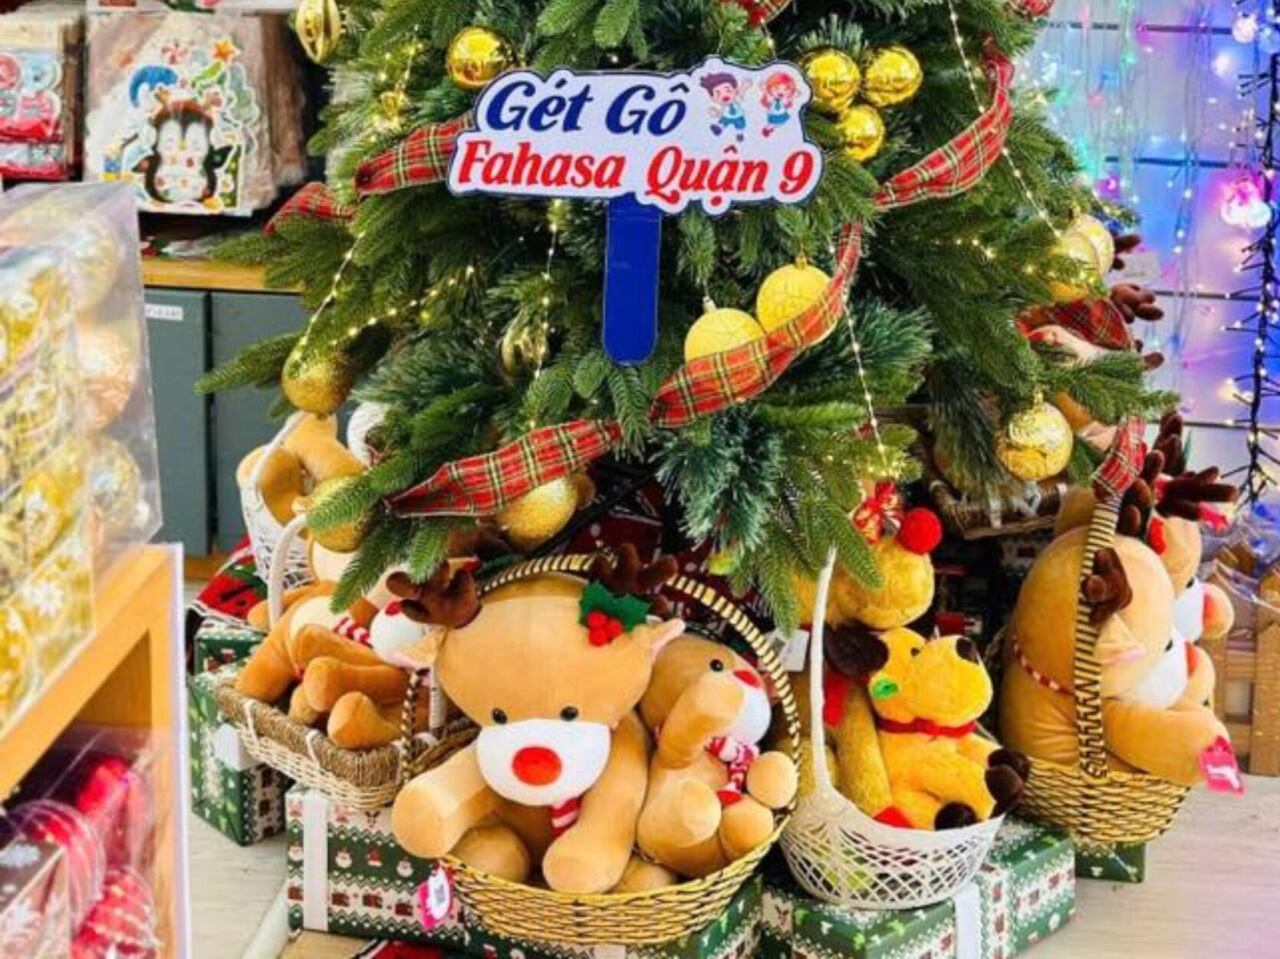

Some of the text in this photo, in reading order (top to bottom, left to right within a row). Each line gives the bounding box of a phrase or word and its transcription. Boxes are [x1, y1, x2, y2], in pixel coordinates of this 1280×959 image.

[486, 78, 690, 137] Gét Gô
[458, 140, 814, 207] Fahasa Quận 9
